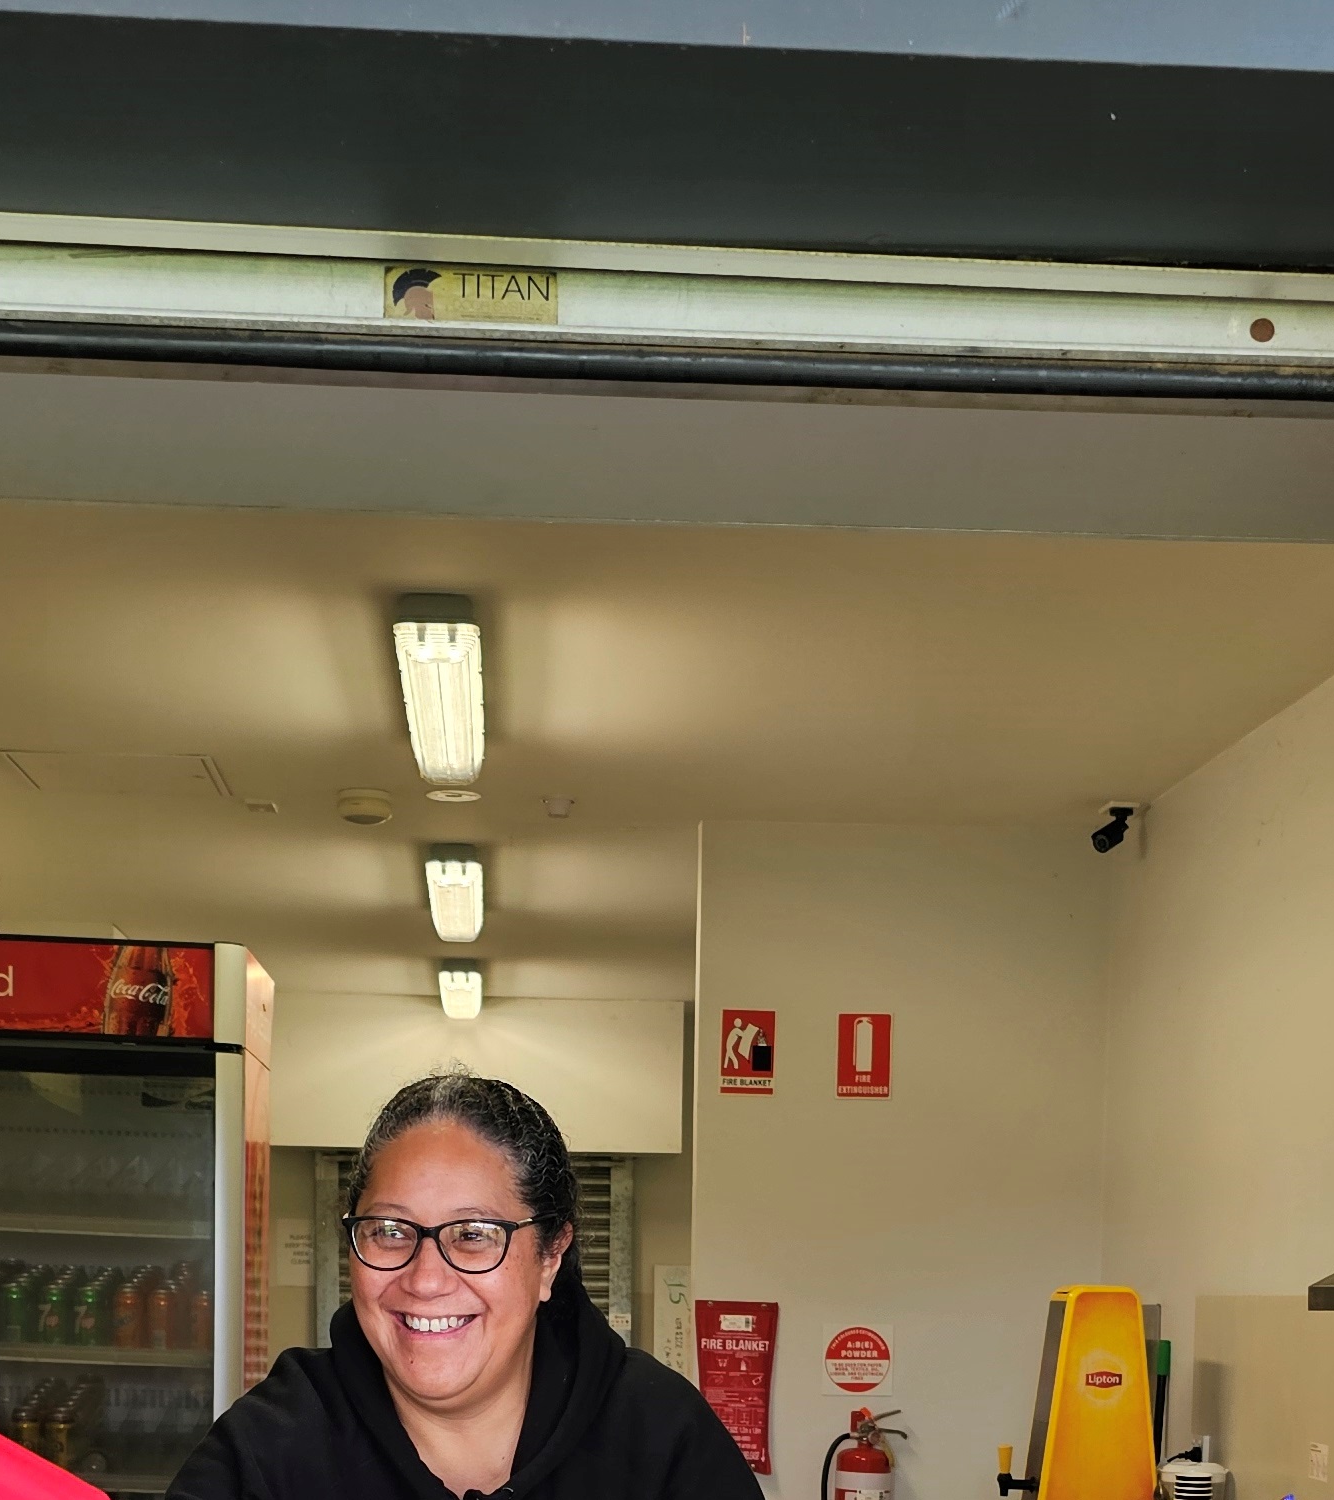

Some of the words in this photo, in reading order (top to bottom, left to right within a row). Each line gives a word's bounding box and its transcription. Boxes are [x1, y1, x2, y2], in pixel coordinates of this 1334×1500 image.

[453, 272, 550, 301] TITAN
[110, 979, 171, 1006] Coca-Cola
[722, 1078, 738, 1086] FIRE
[739, 1079, 772, 1087] BLANKET
[854, 1074, 871, 1083] FIRE
[838, 1085, 888, 1095] EXTINGUISHER
[701, 1338, 724, 1350] FIRE
[725, 1340, 770, 1351] BLANKET
[840, 1350, 878, 1358] POWDER
[1088, 1373, 1120, 1386] Lipton
